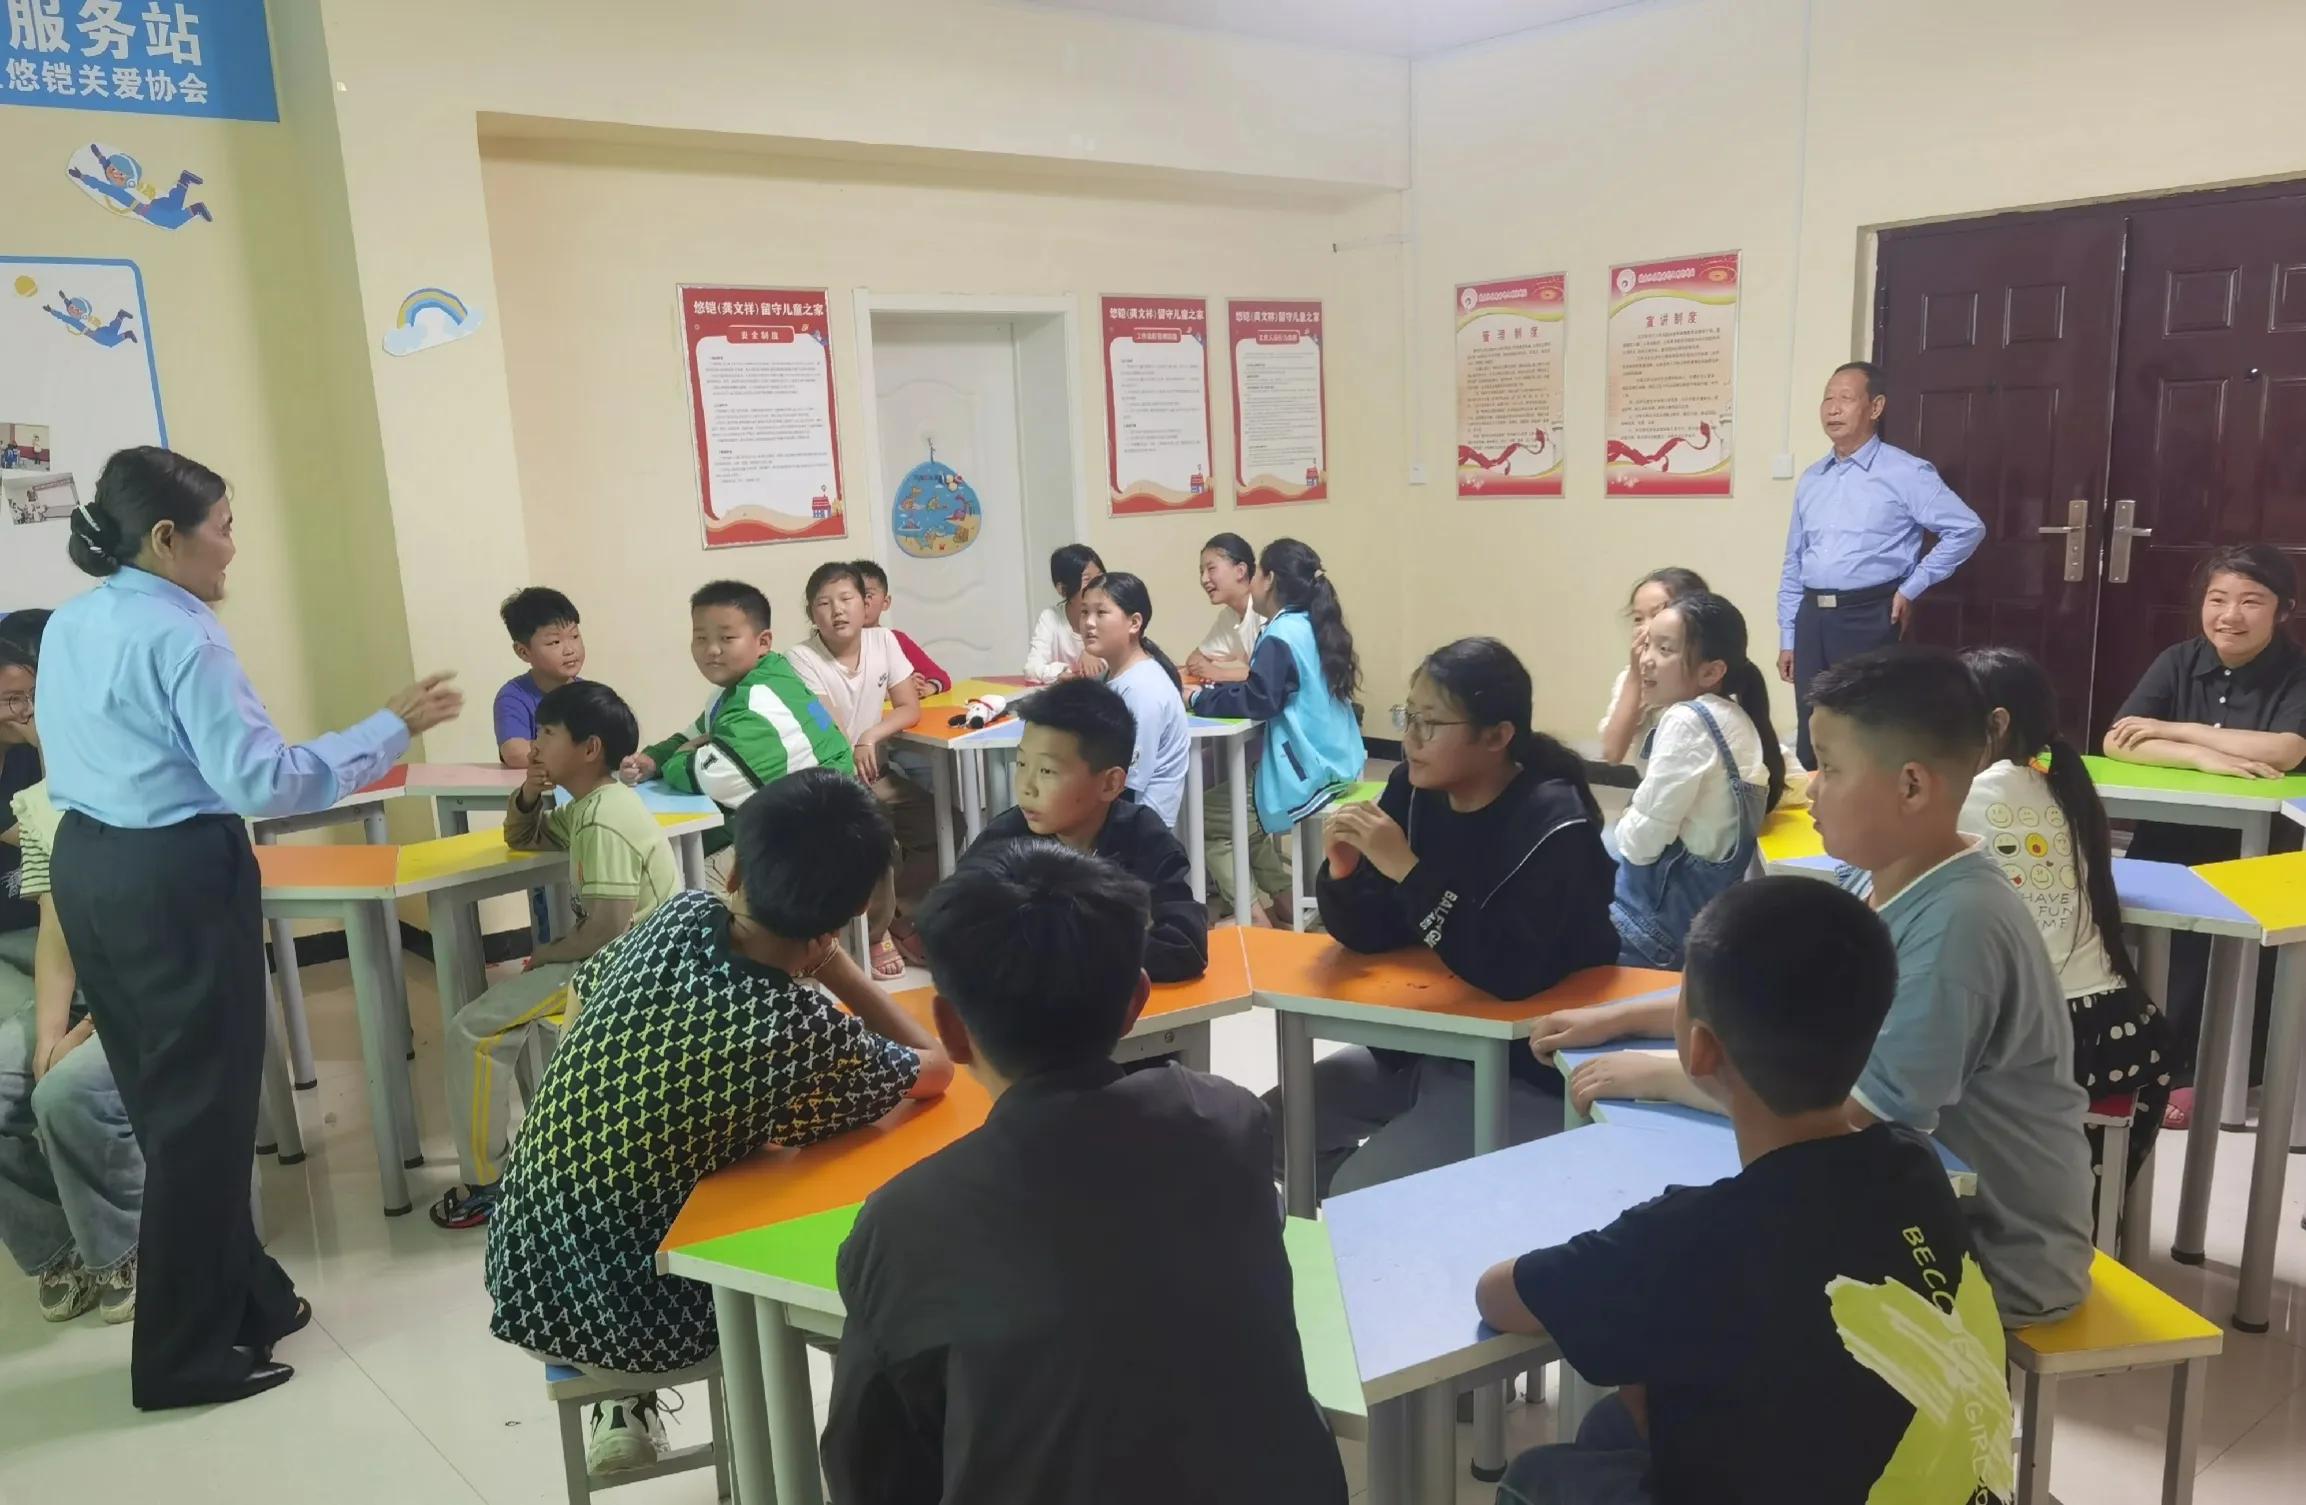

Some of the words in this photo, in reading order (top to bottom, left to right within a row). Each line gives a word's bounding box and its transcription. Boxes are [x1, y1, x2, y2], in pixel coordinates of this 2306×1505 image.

[8, 0, 202, 66] 服务站
[0, 57, 208, 104] 悠铠关爱协会
[2039, 905, 2073, 917] FUN
